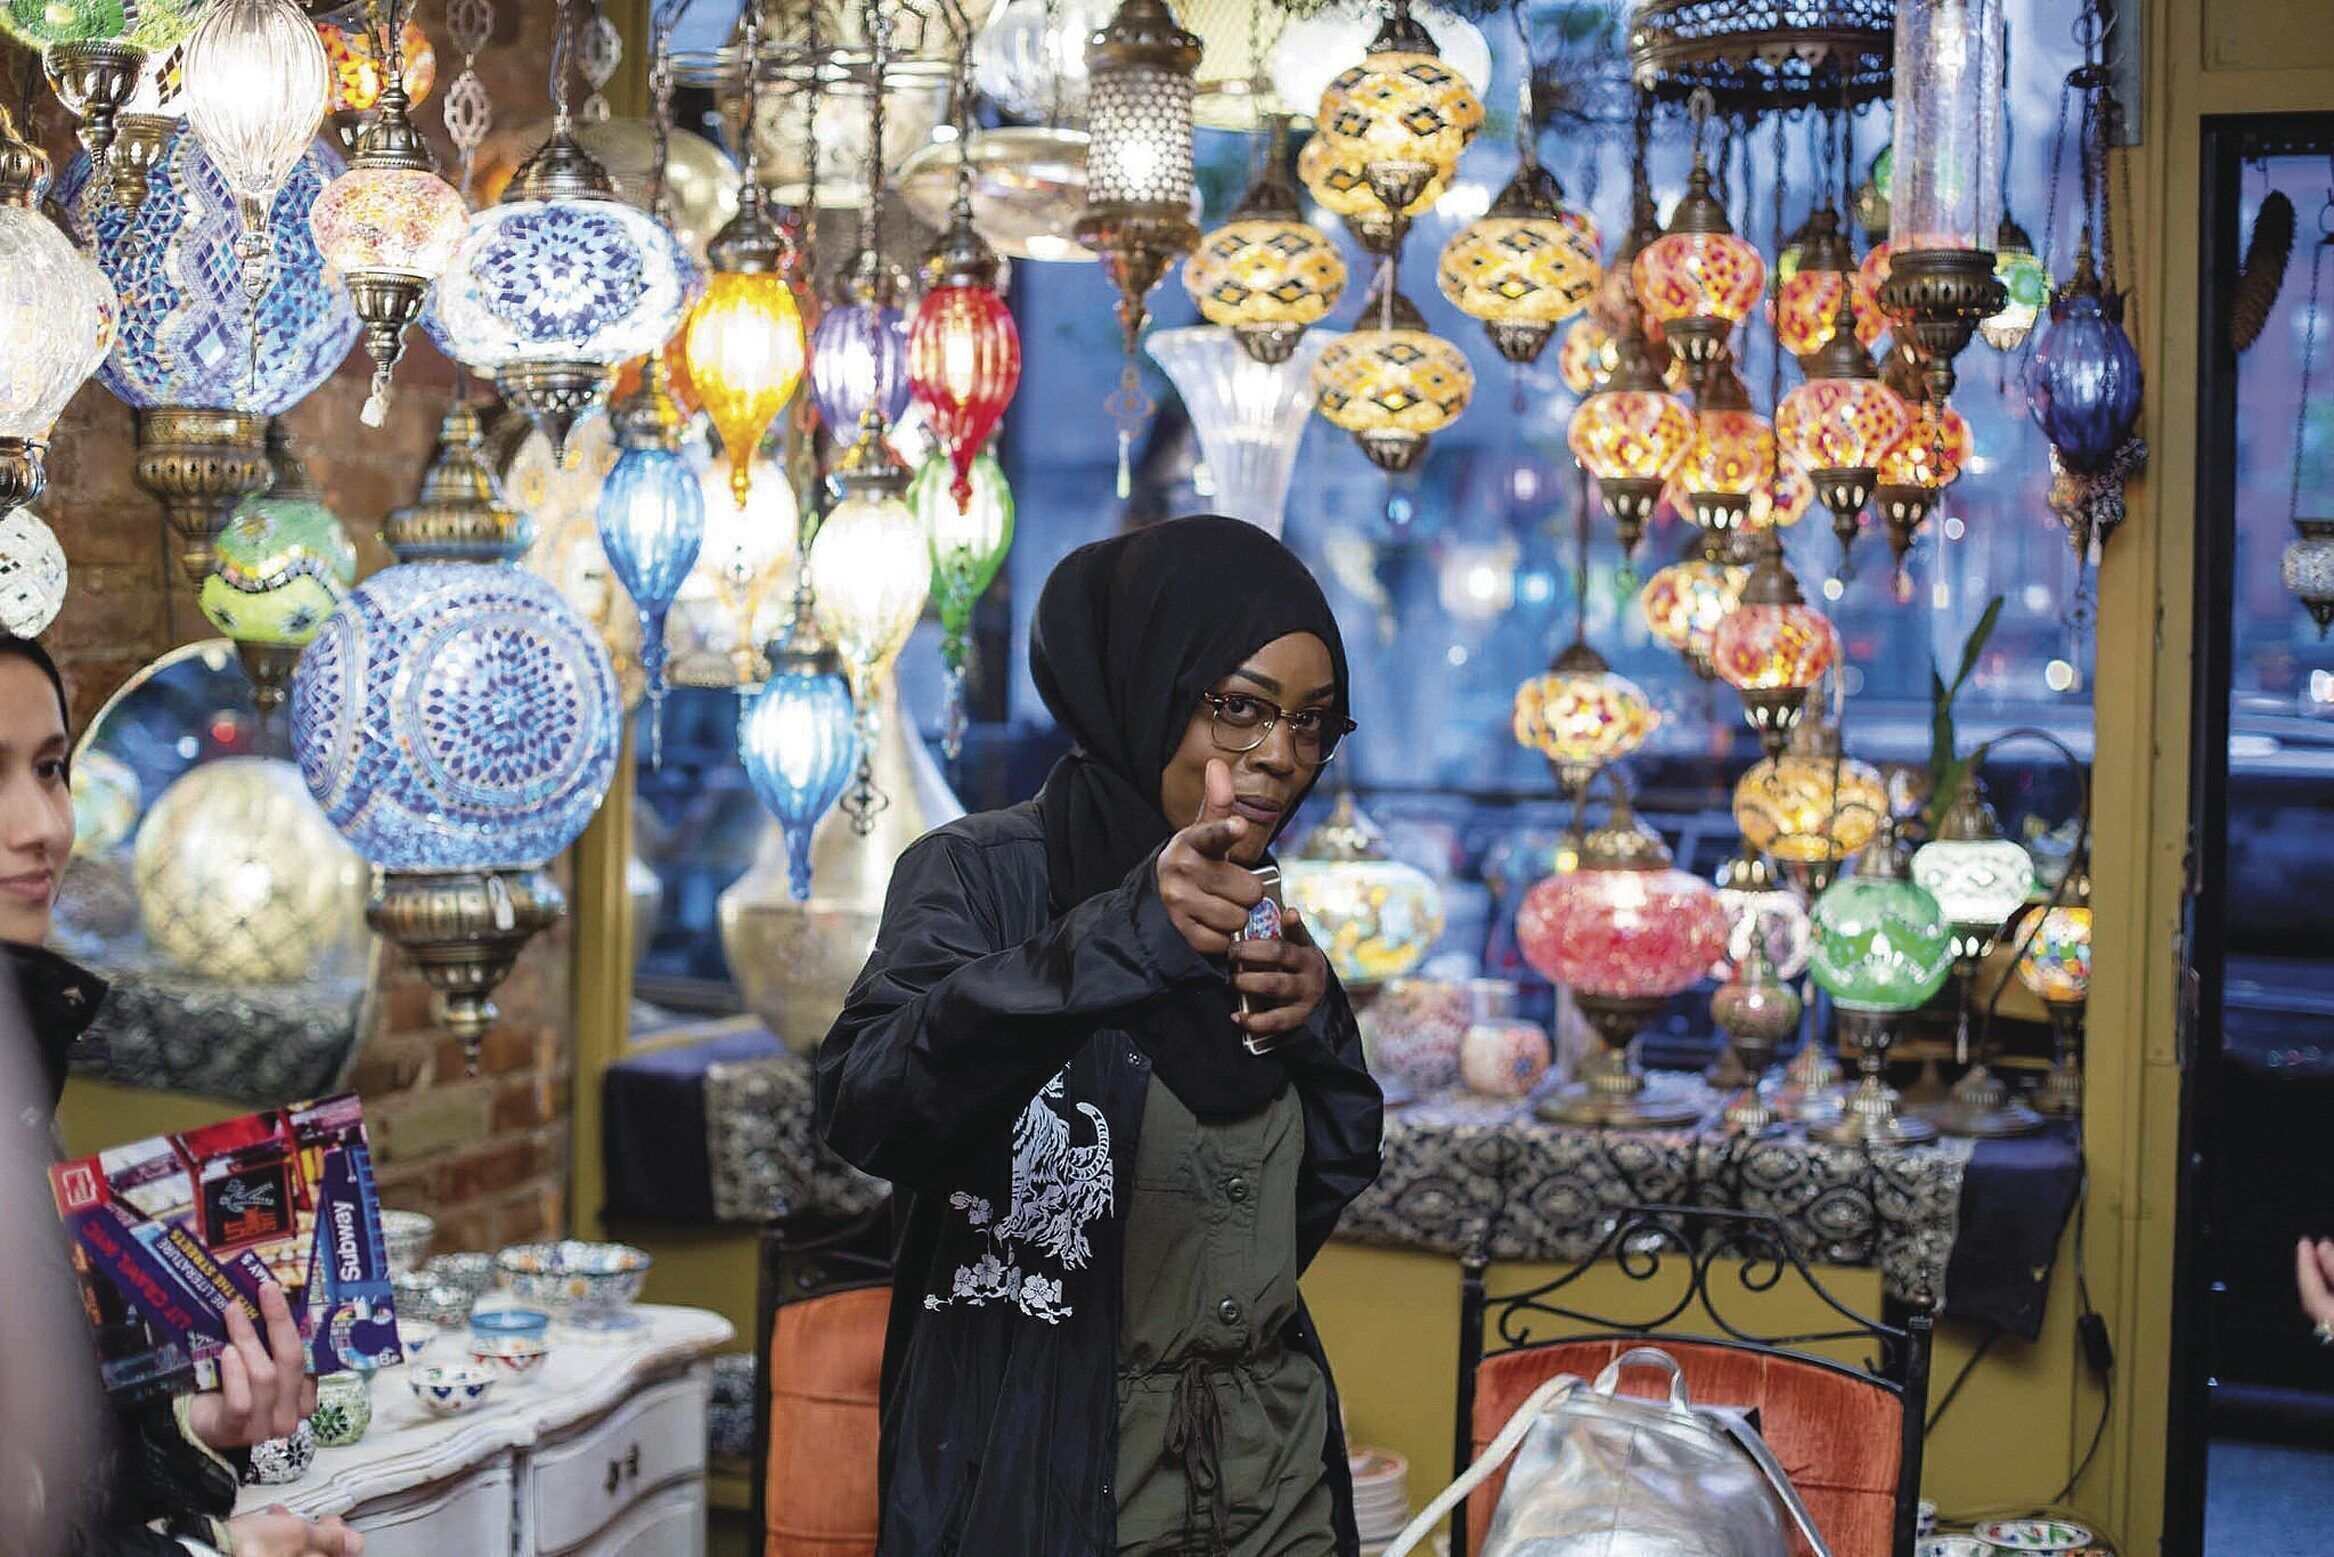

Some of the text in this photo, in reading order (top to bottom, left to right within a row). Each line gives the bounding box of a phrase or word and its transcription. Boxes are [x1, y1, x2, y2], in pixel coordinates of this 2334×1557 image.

[156, 1237, 215, 1297] LITERATURE
[168, 1228, 217, 1277] STREETS
[334, 1200, 362, 1281] Subway
[118, 1252, 171, 1309] CRAWL
[211, 1272, 235, 1296] THE
